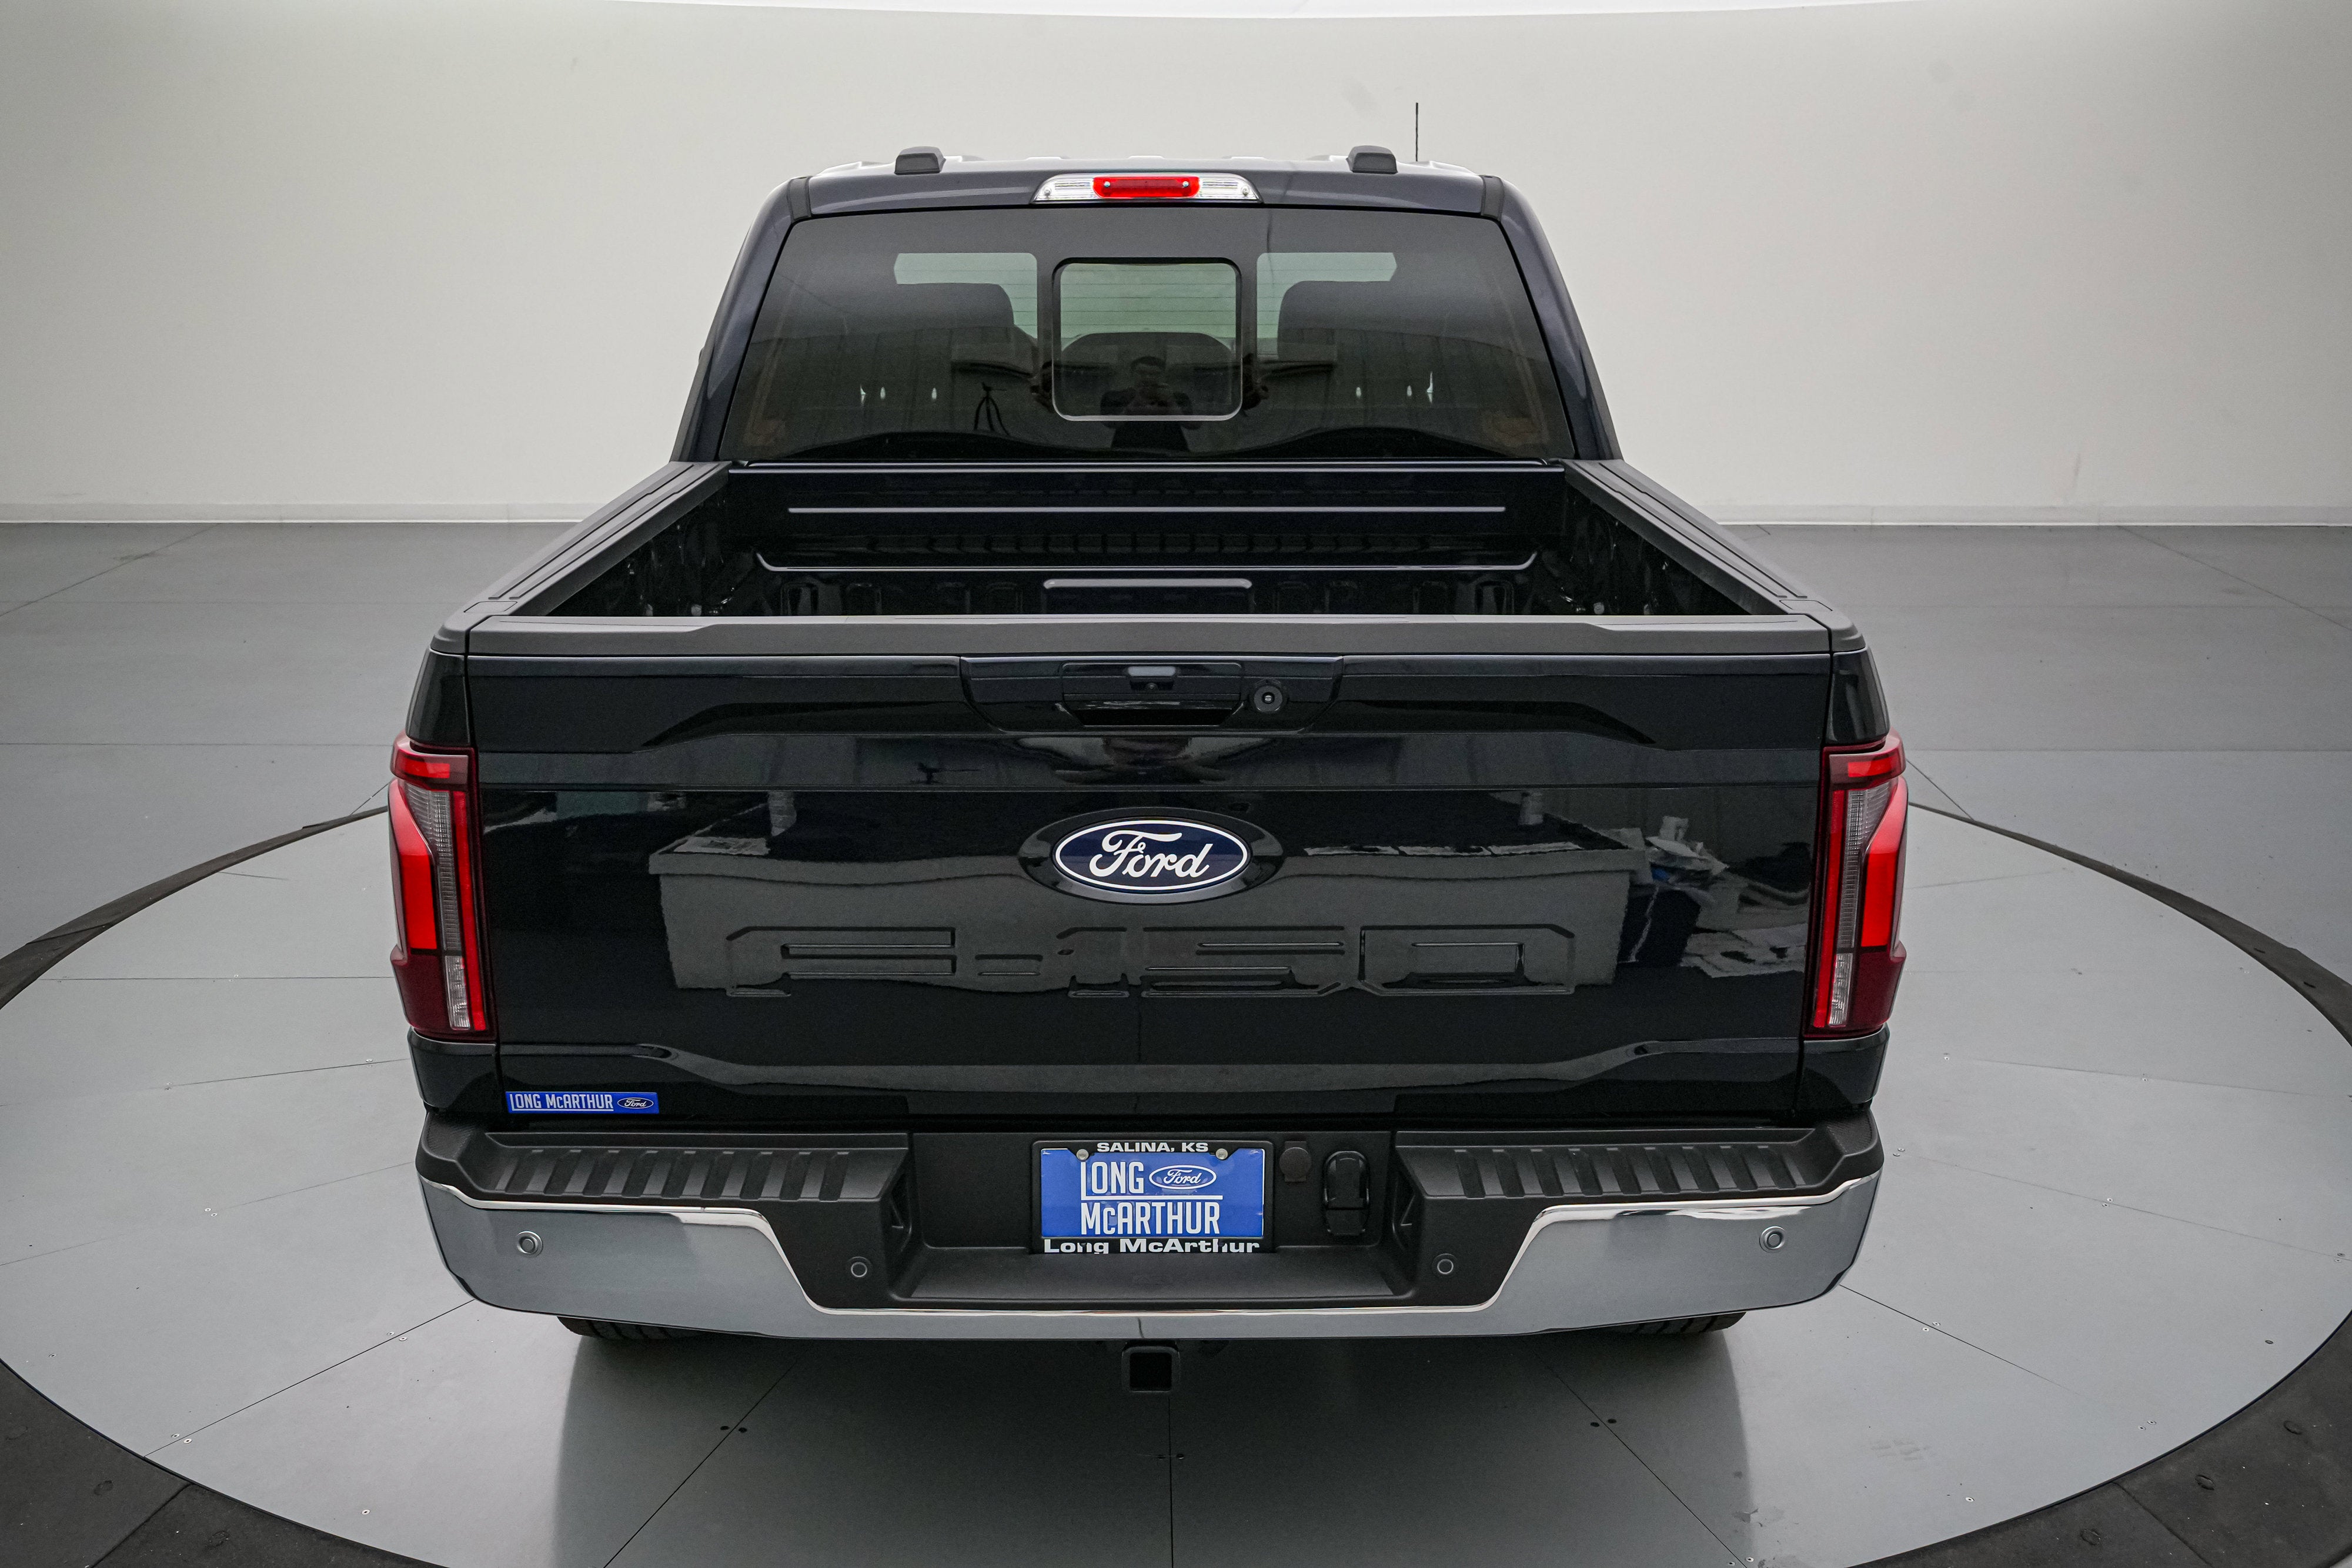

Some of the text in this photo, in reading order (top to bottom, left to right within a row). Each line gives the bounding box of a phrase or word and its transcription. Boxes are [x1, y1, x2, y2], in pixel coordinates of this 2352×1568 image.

[1089, 830, 1213, 878] Ford
[726, 925, 1575, 997] F-150
[509, 1094, 613, 1111] LONG McARTHUR
[624, 1098, 647, 1108] Ford
[1097, 1142, 1209, 1152] SALINA, KS
[1081, 1161, 1144, 1197] LONG
[1163, 1169, 1201, 1185] Ford
[1081, 1202, 1220, 1235] McARTHUR
[1044, 1238, 1260, 1254] Long McArthur
